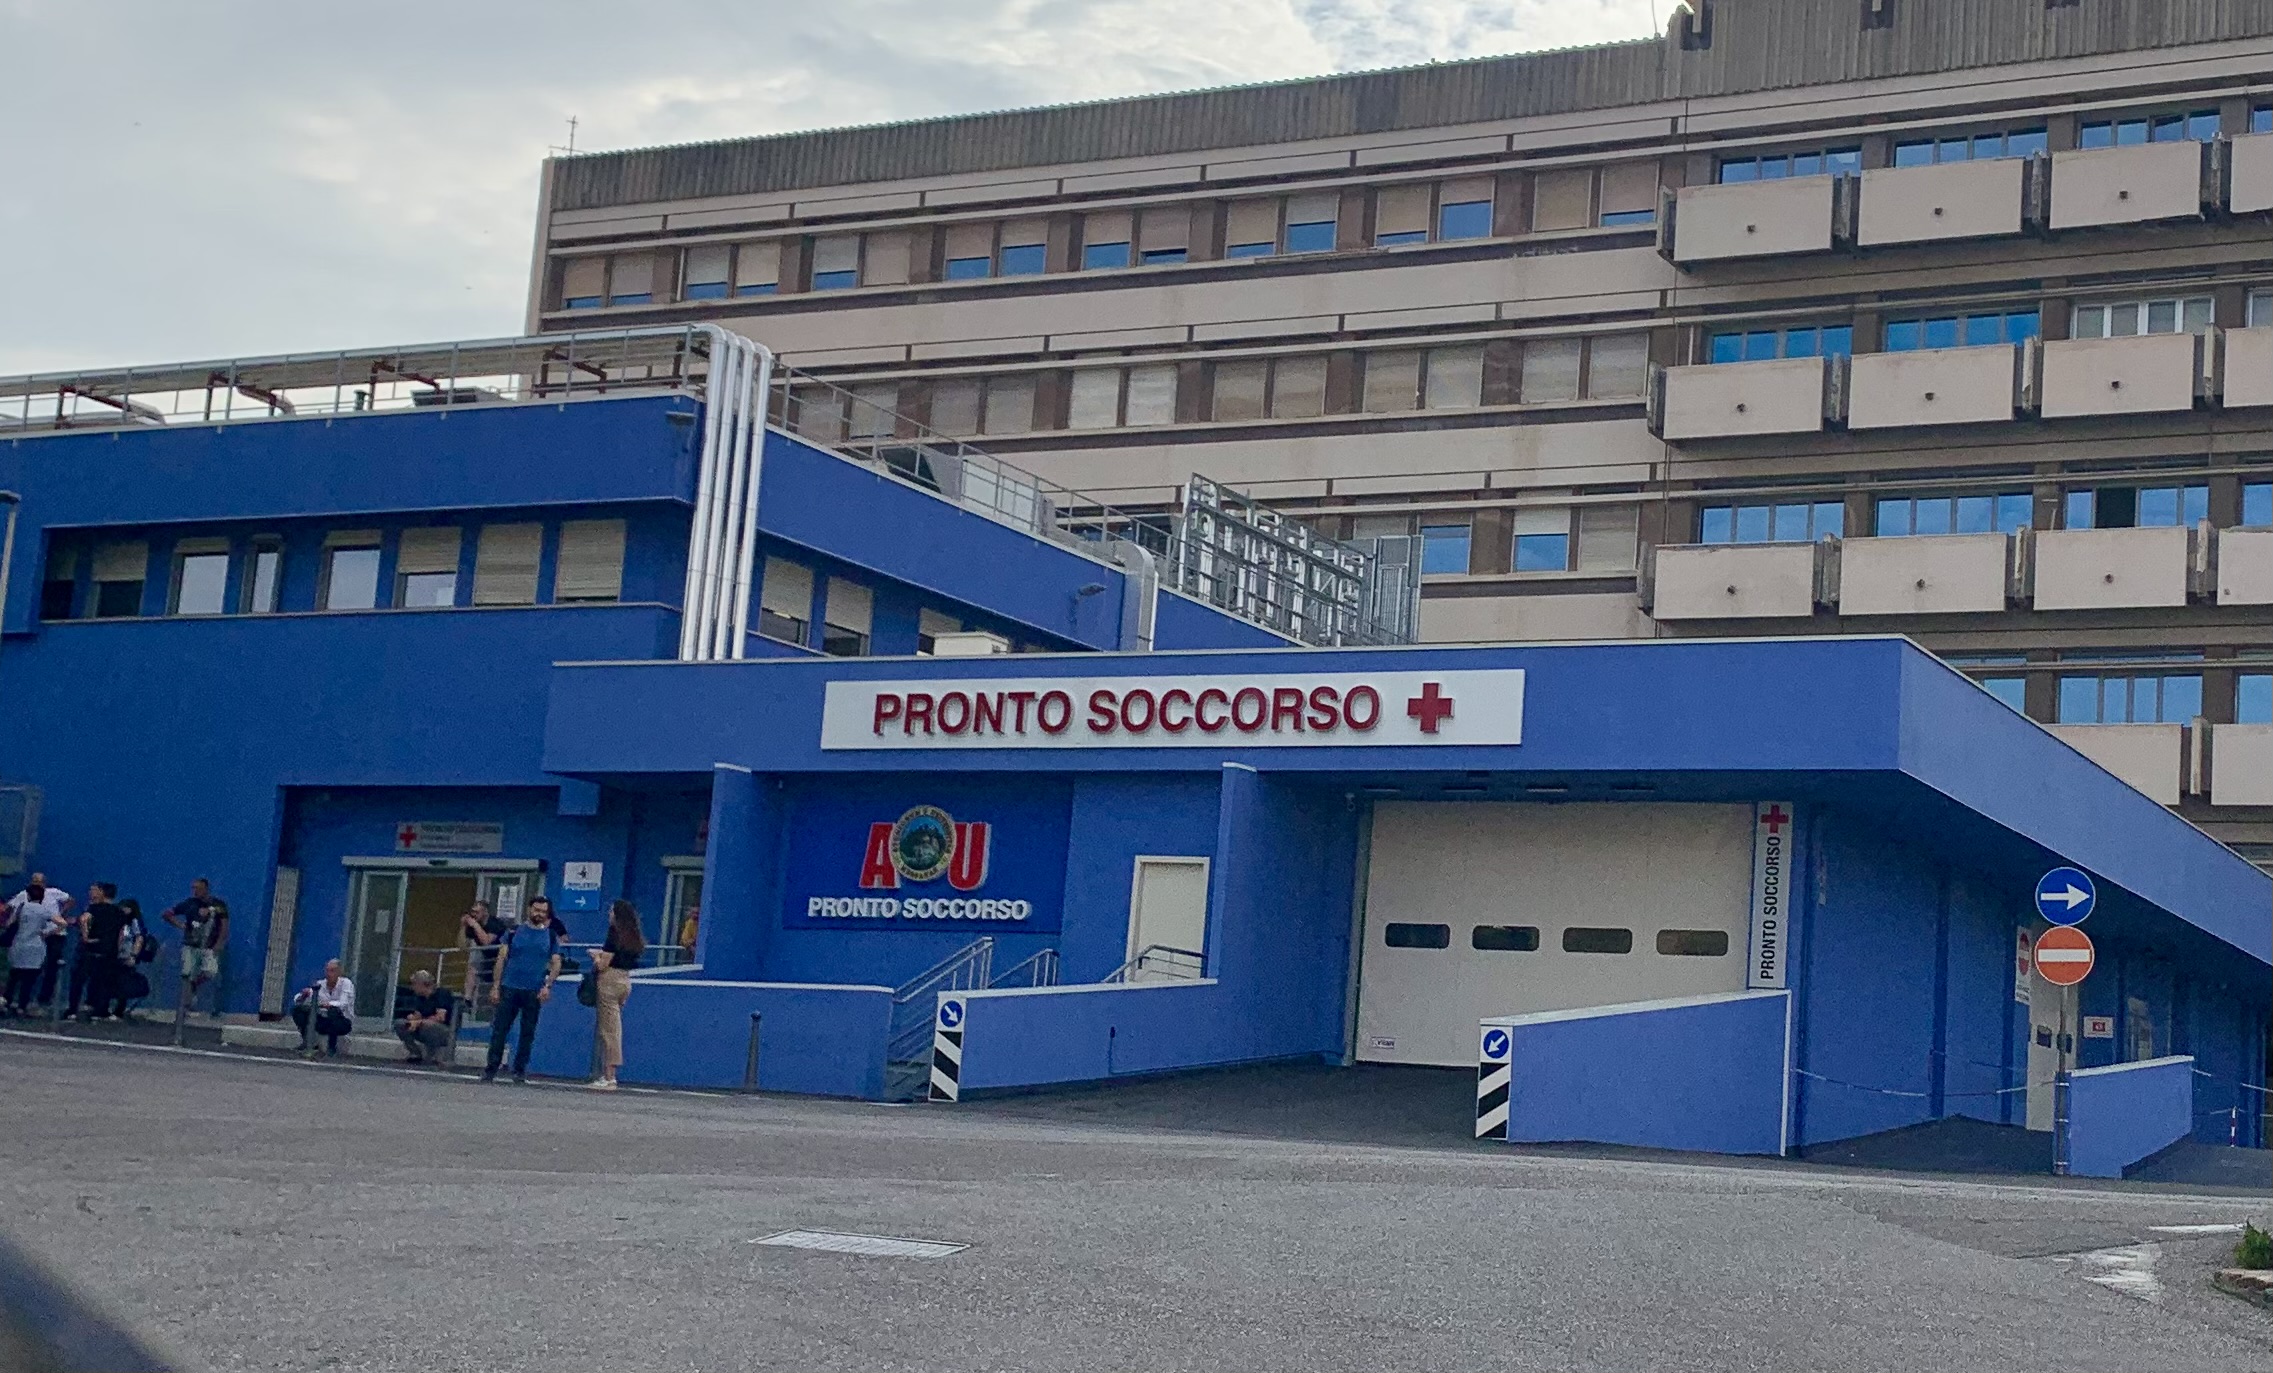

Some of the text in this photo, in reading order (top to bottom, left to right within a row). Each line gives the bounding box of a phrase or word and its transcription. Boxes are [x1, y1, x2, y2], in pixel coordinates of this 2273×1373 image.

[873, 684, 1381, 736] PRONTO SOCCORSO
[808, 896, 1032, 920] PRONTO SOCCORSO
[1760, 836, 1781, 980] PRONTO SOCCORSO
